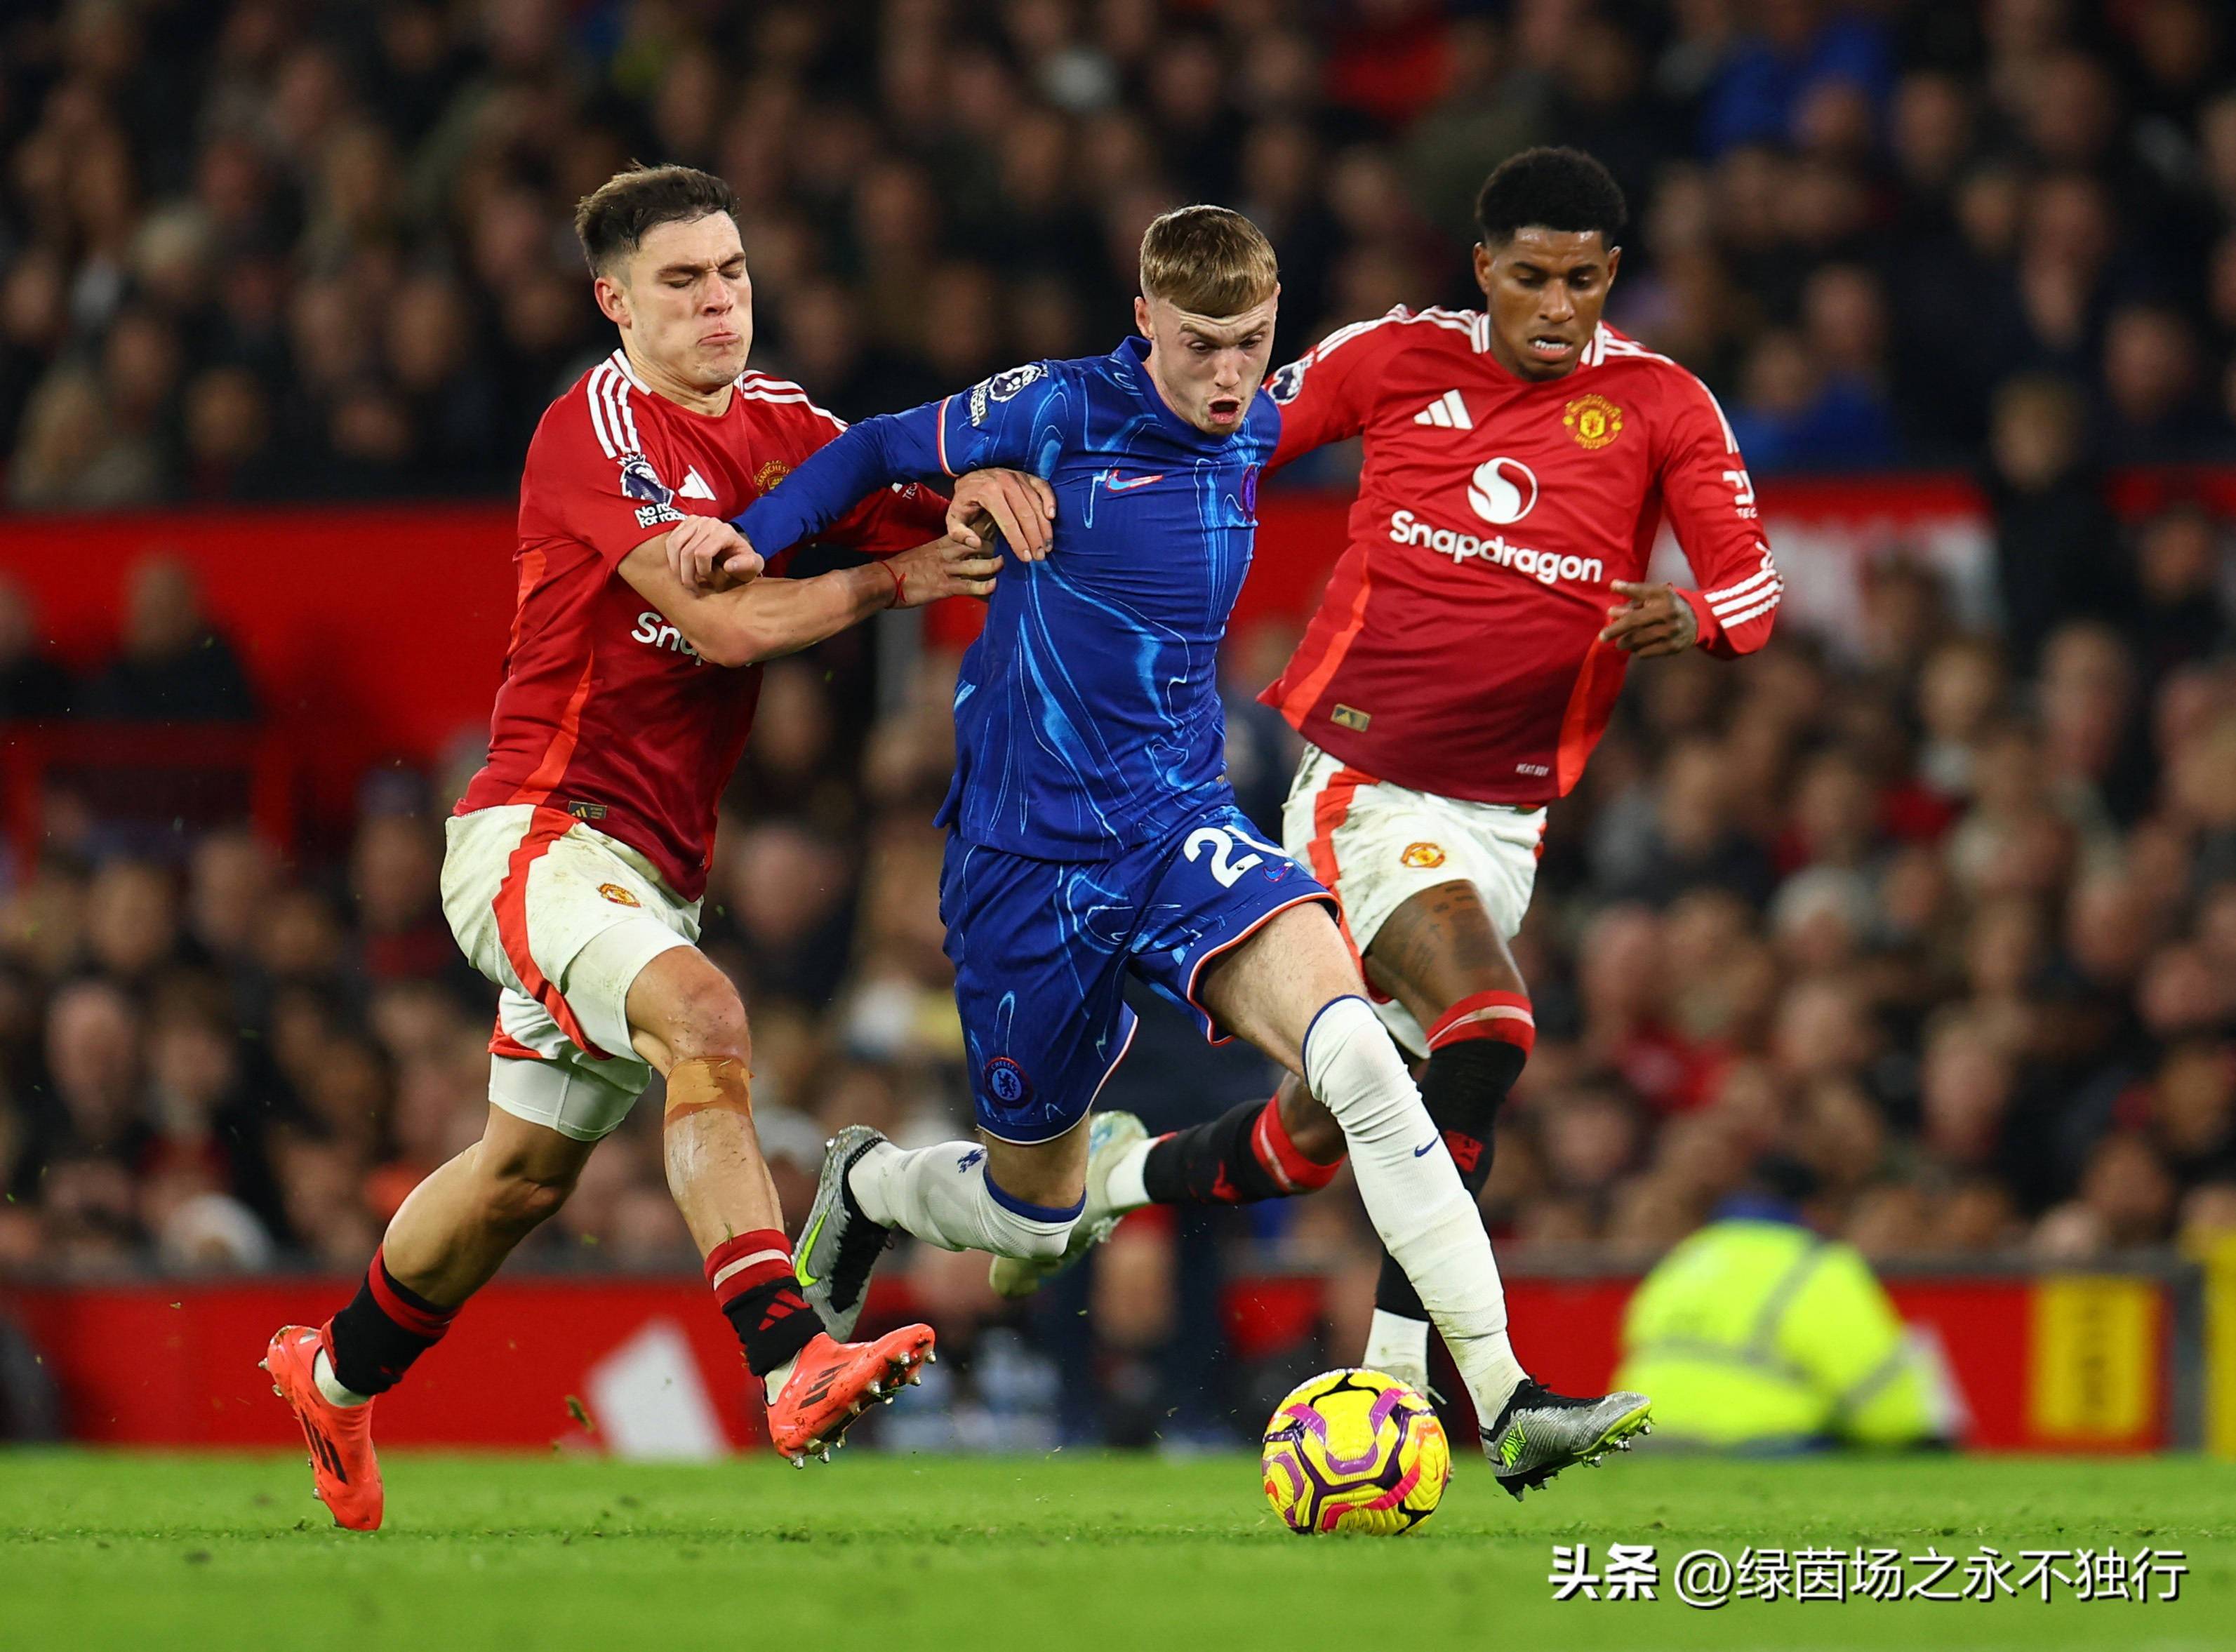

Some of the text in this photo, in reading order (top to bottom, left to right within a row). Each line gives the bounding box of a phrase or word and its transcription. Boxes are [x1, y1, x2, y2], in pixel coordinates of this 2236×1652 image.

[634, 506, 656, 517] No
[1389, 509, 1602, 585] Snapdragon
[631, 611, 702, 667] Sna
